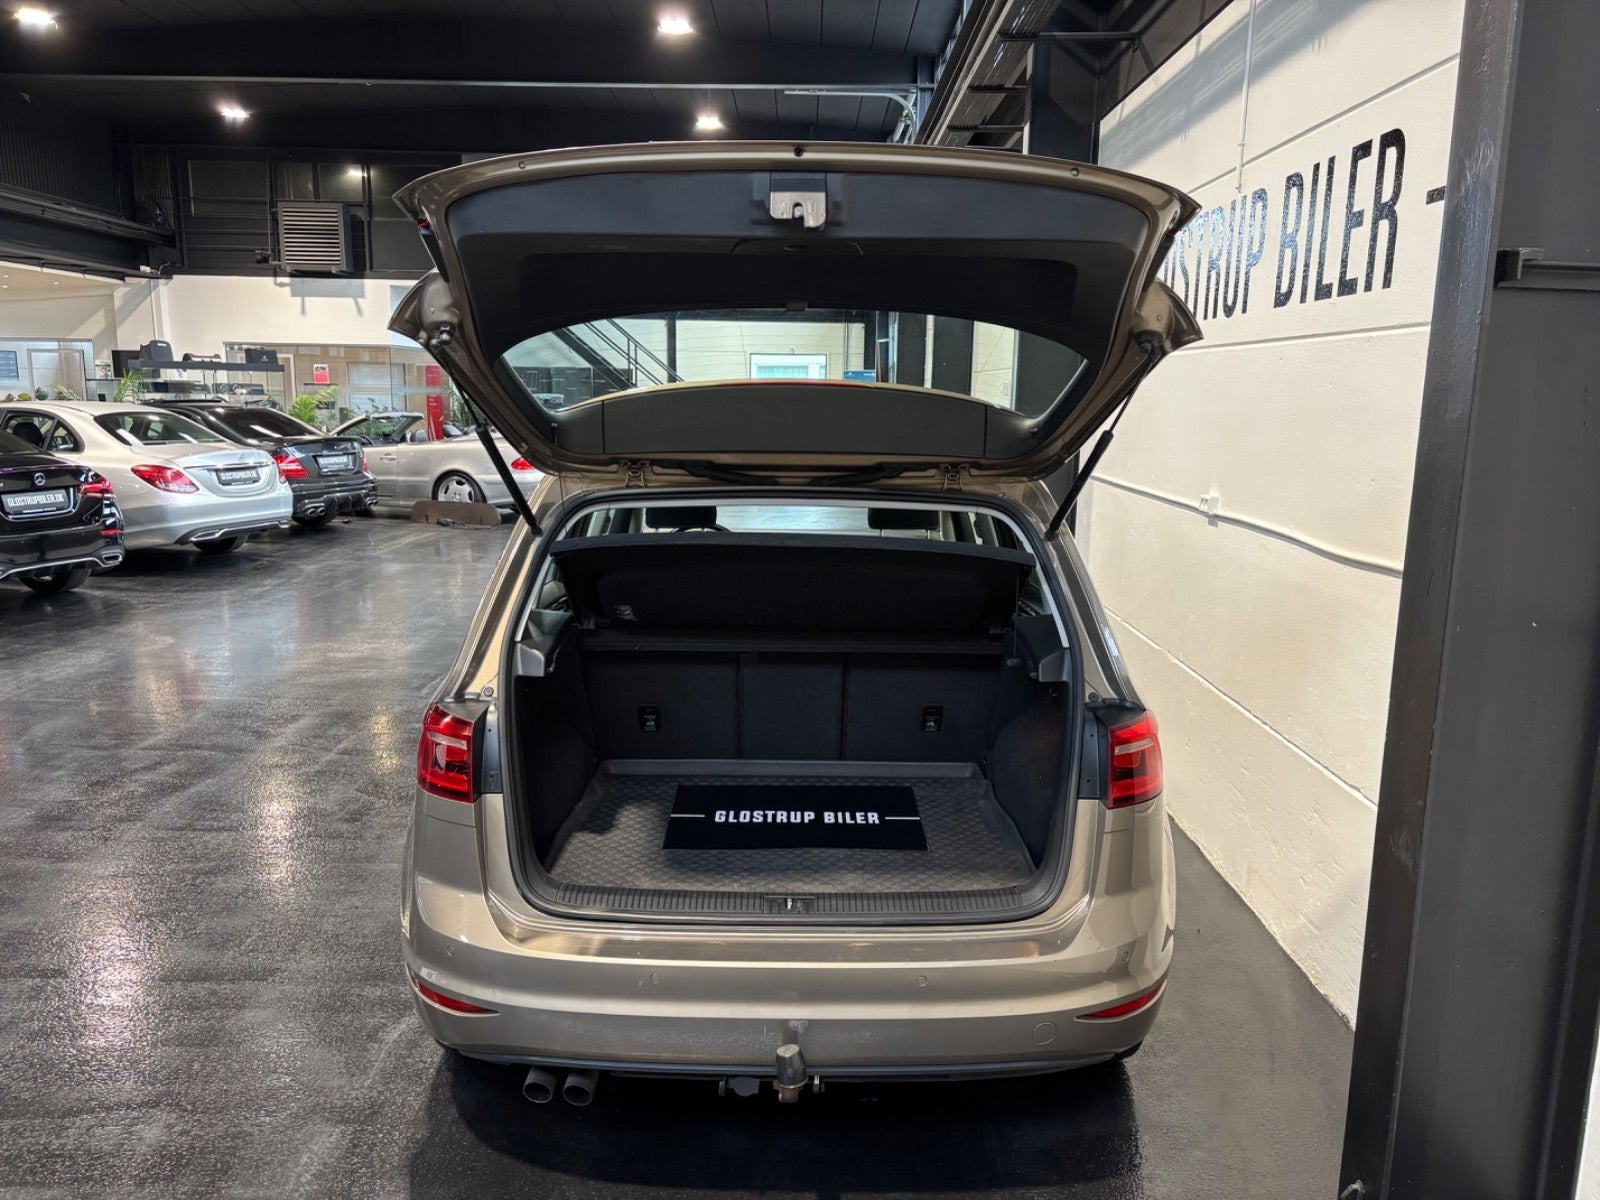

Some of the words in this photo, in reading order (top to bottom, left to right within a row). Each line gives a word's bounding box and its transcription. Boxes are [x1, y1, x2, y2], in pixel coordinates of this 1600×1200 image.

[1273, 128, 1406, 308] BILER
[714, 810, 816, 824] GLOSTRUP
[823, 811, 881, 825] BILER
